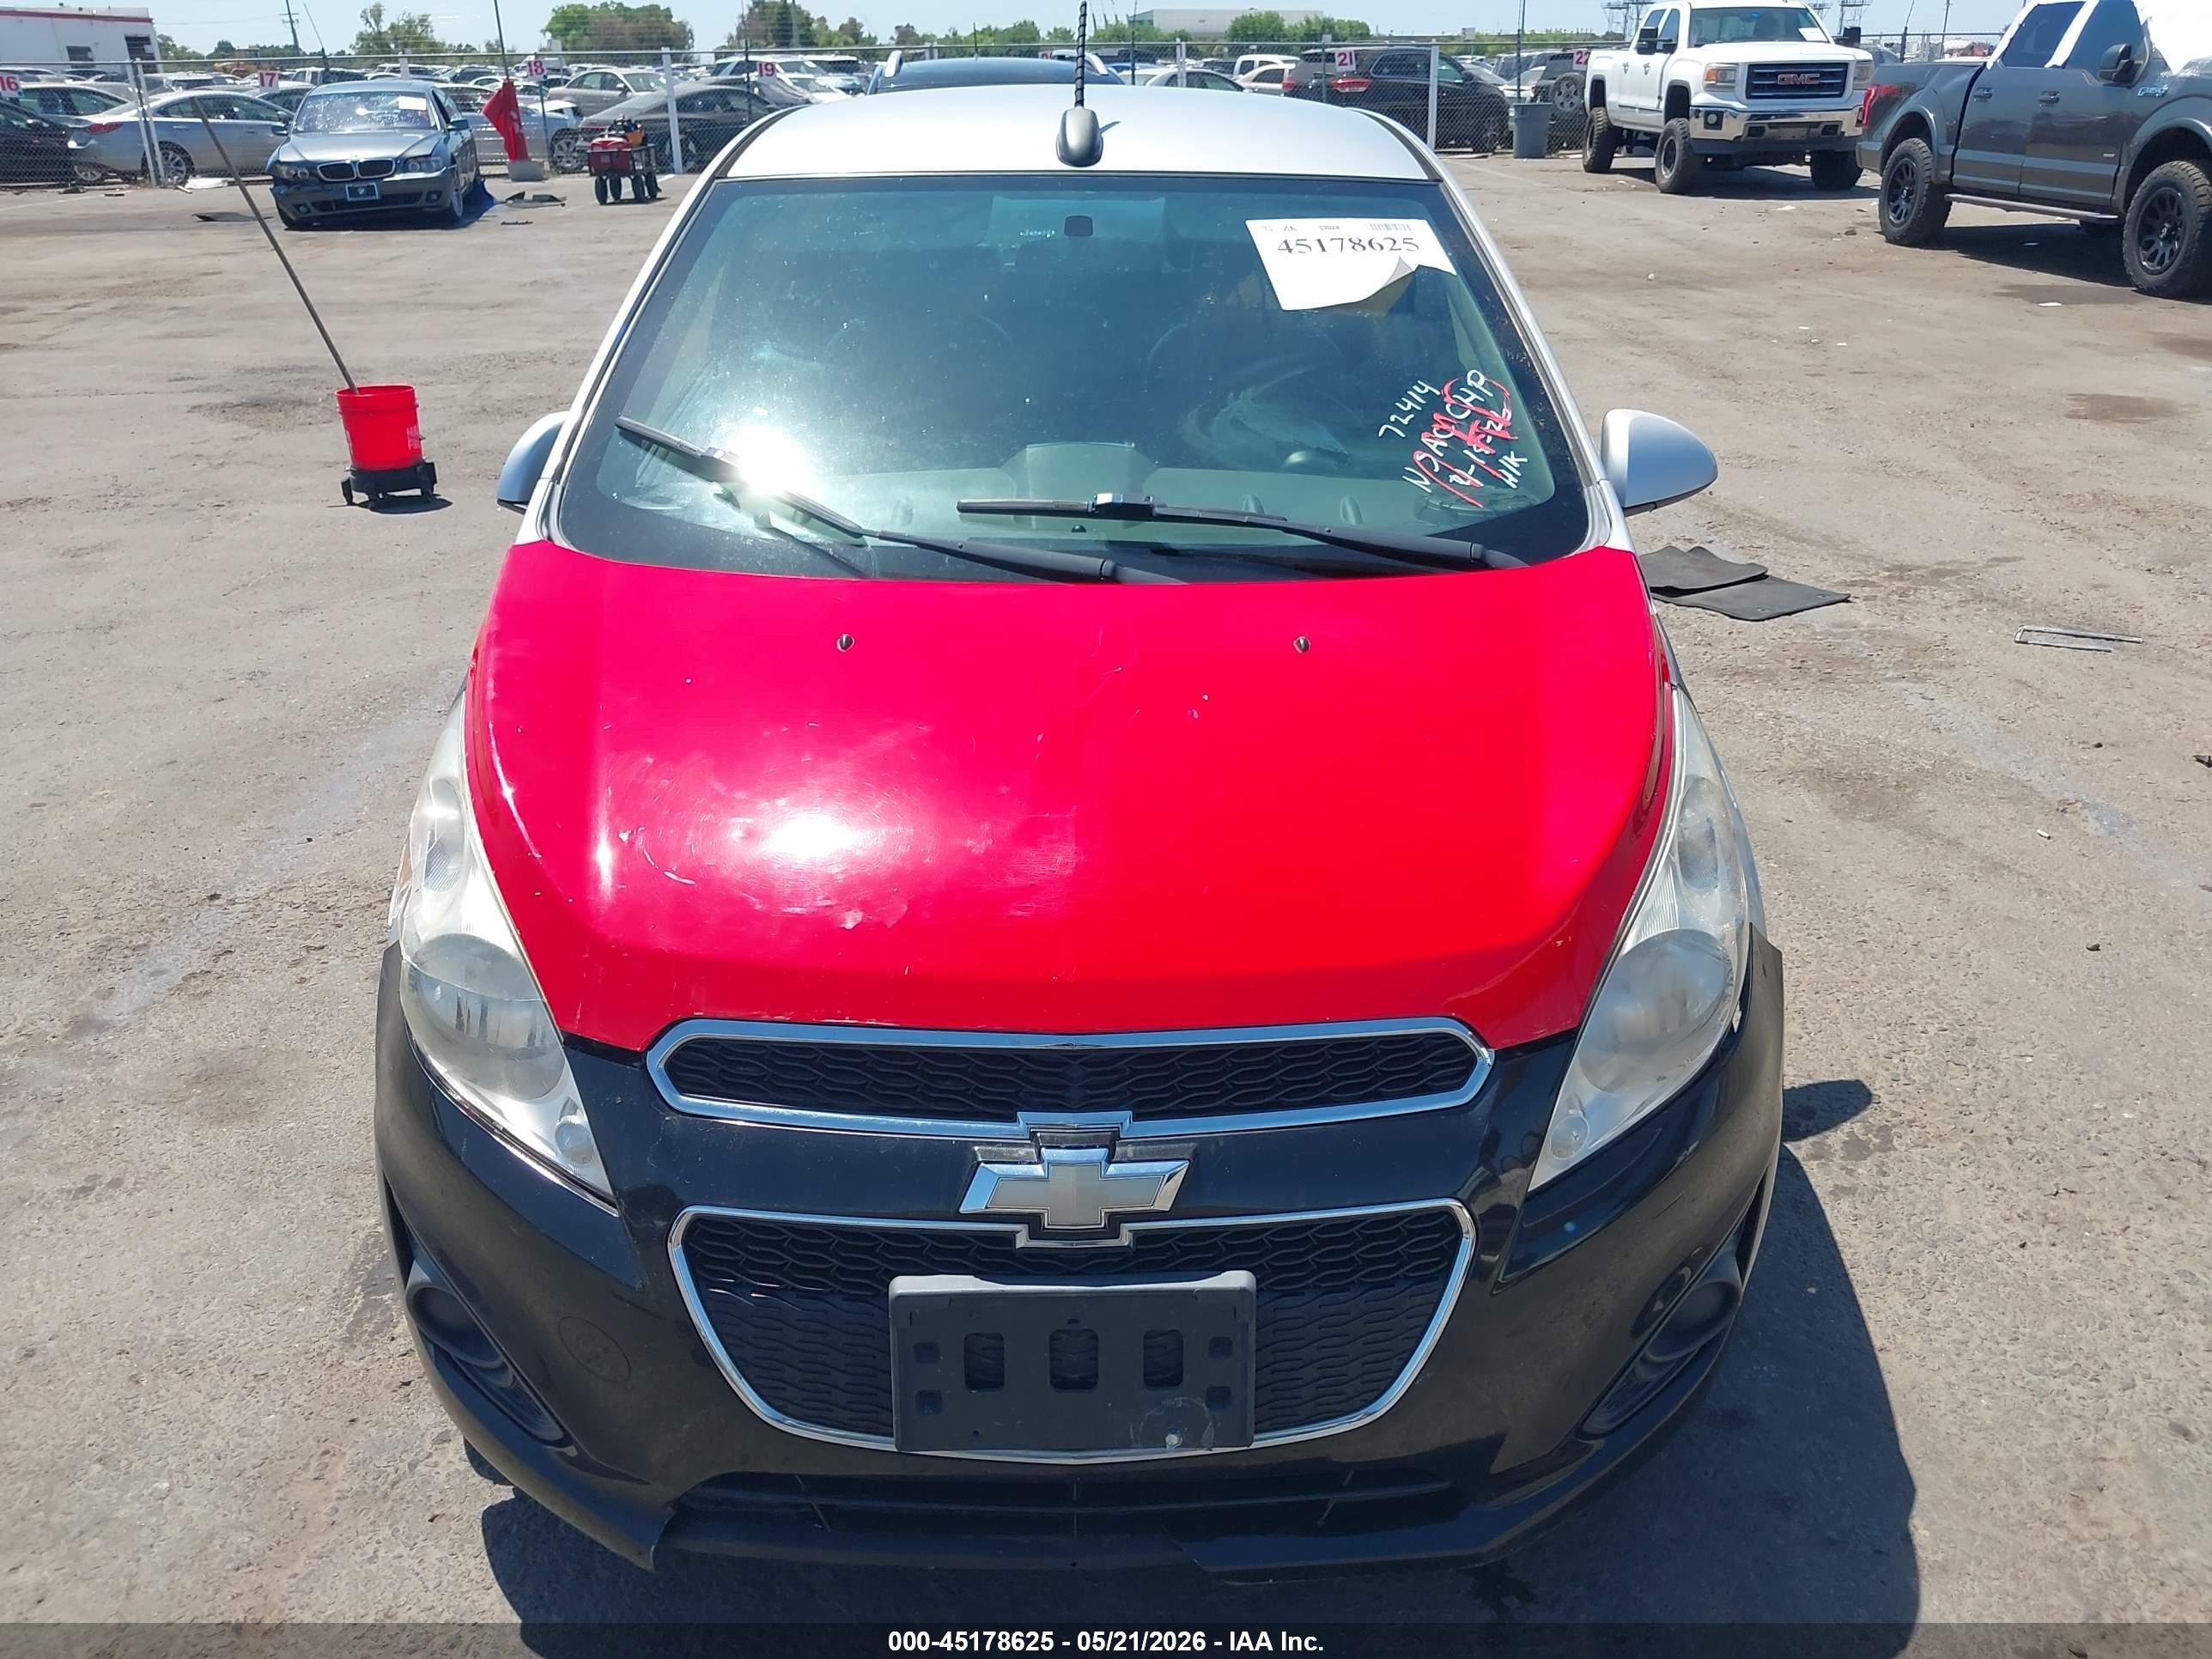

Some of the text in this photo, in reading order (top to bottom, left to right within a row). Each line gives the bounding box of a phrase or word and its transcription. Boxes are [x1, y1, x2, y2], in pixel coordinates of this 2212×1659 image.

[1338, 52, 1353, 67] 21
[1575, 51, 1590, 65] 22
[527, 60, 545, 76] 18
[758, 62, 776, 77] 19
[0, 76, 19, 91] 16
[259, 72, 276, 88] 17
[1778, 73, 1820, 85] GMC
[1278, 237, 1419, 254] 45178625
[1378, 380, 1441, 437] 72414
